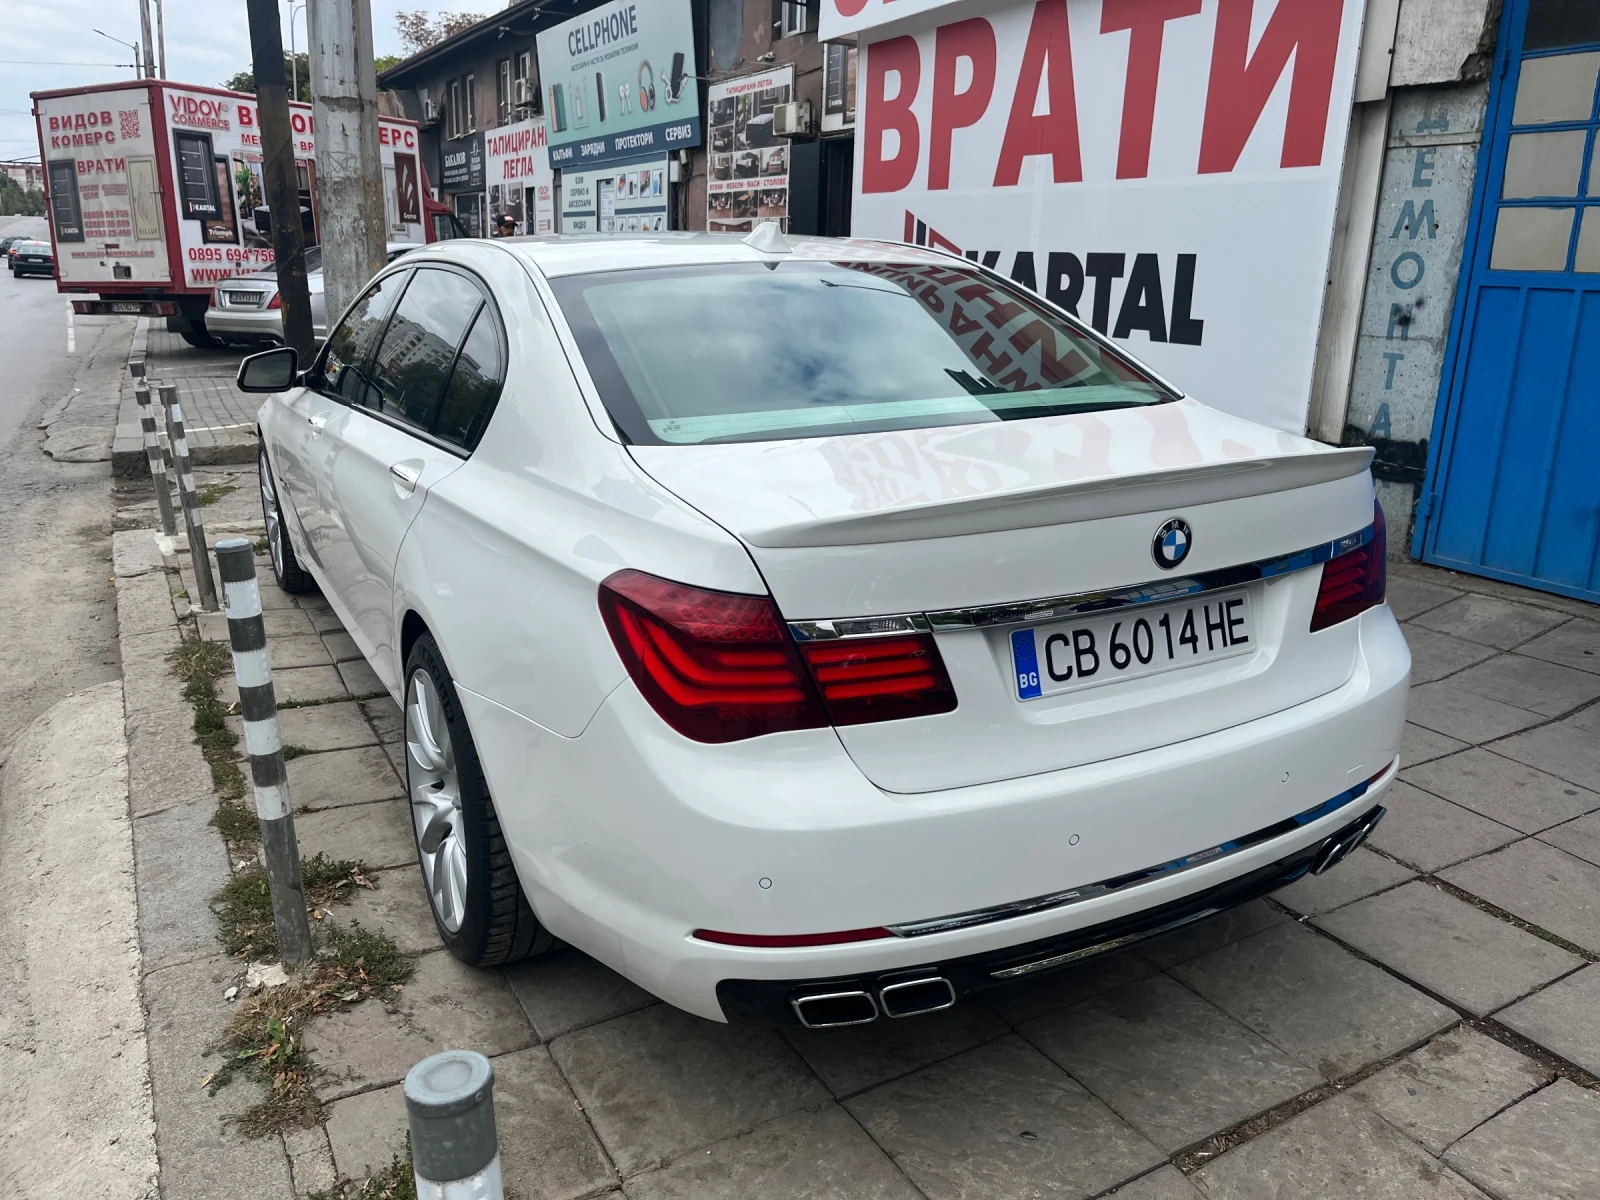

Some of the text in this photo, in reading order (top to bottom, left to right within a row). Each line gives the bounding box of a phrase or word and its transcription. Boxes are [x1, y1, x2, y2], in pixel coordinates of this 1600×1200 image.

[568, 4, 638, 57] CELLPHONE
[726, 78, 773, 95] ТАПИЦИРАНИ ЛЕГЛА
[170, 95, 222, 118] VIDOV
[862, 0, 1342, 194] ВРАТИ
[49, 111, 113, 131] ВИДОВ
[172, 113, 230, 131] COMMERCE
[52, 131, 116, 149] КОМЕРС
[552, 124, 692, 161] КАЛЪФИ ЗАРЯДНИ ПРОТЕКТОРИ СЕРВИЗ
[77, 158, 126, 174] ВРАТИ
[503, 156, 534, 179] ЛЕГЛА
[195, 203, 216, 212] KARTAL
[208, 228, 233, 237] Triumph
[189, 248, 275, 262] 0895 694 756
[1369, 96, 1450, 488] ДЕМОНТА
[1045, 598, 1249, 682] CB 6014 HE
[1019, 672, 1038, 689] BG
